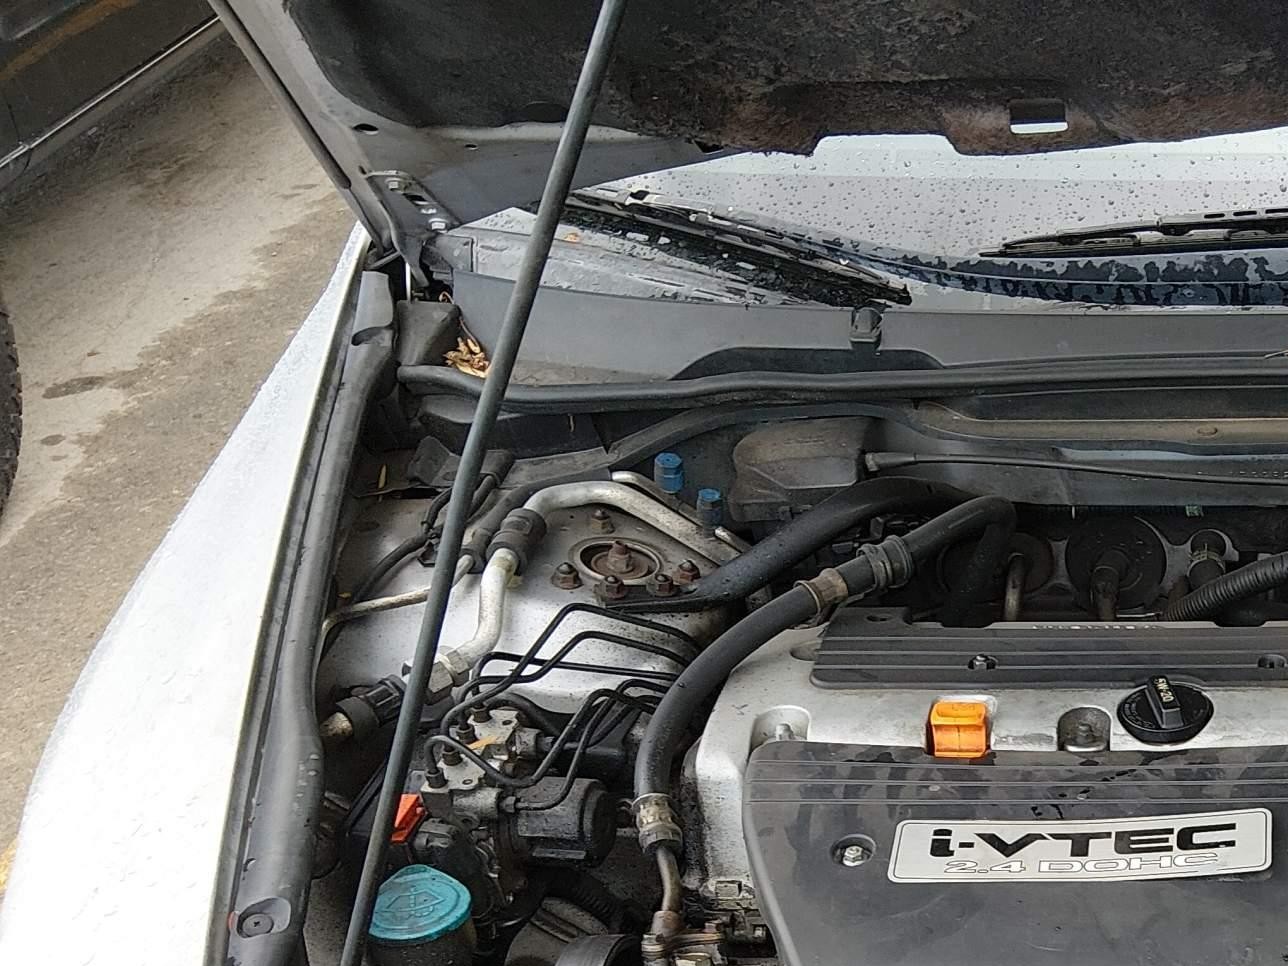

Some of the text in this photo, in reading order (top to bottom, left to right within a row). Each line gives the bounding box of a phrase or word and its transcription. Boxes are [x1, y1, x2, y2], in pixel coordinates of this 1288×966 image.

[929, 822, 1237, 858] i-VTEC
[944, 852, 1219, 874] 2.4 DOHC
